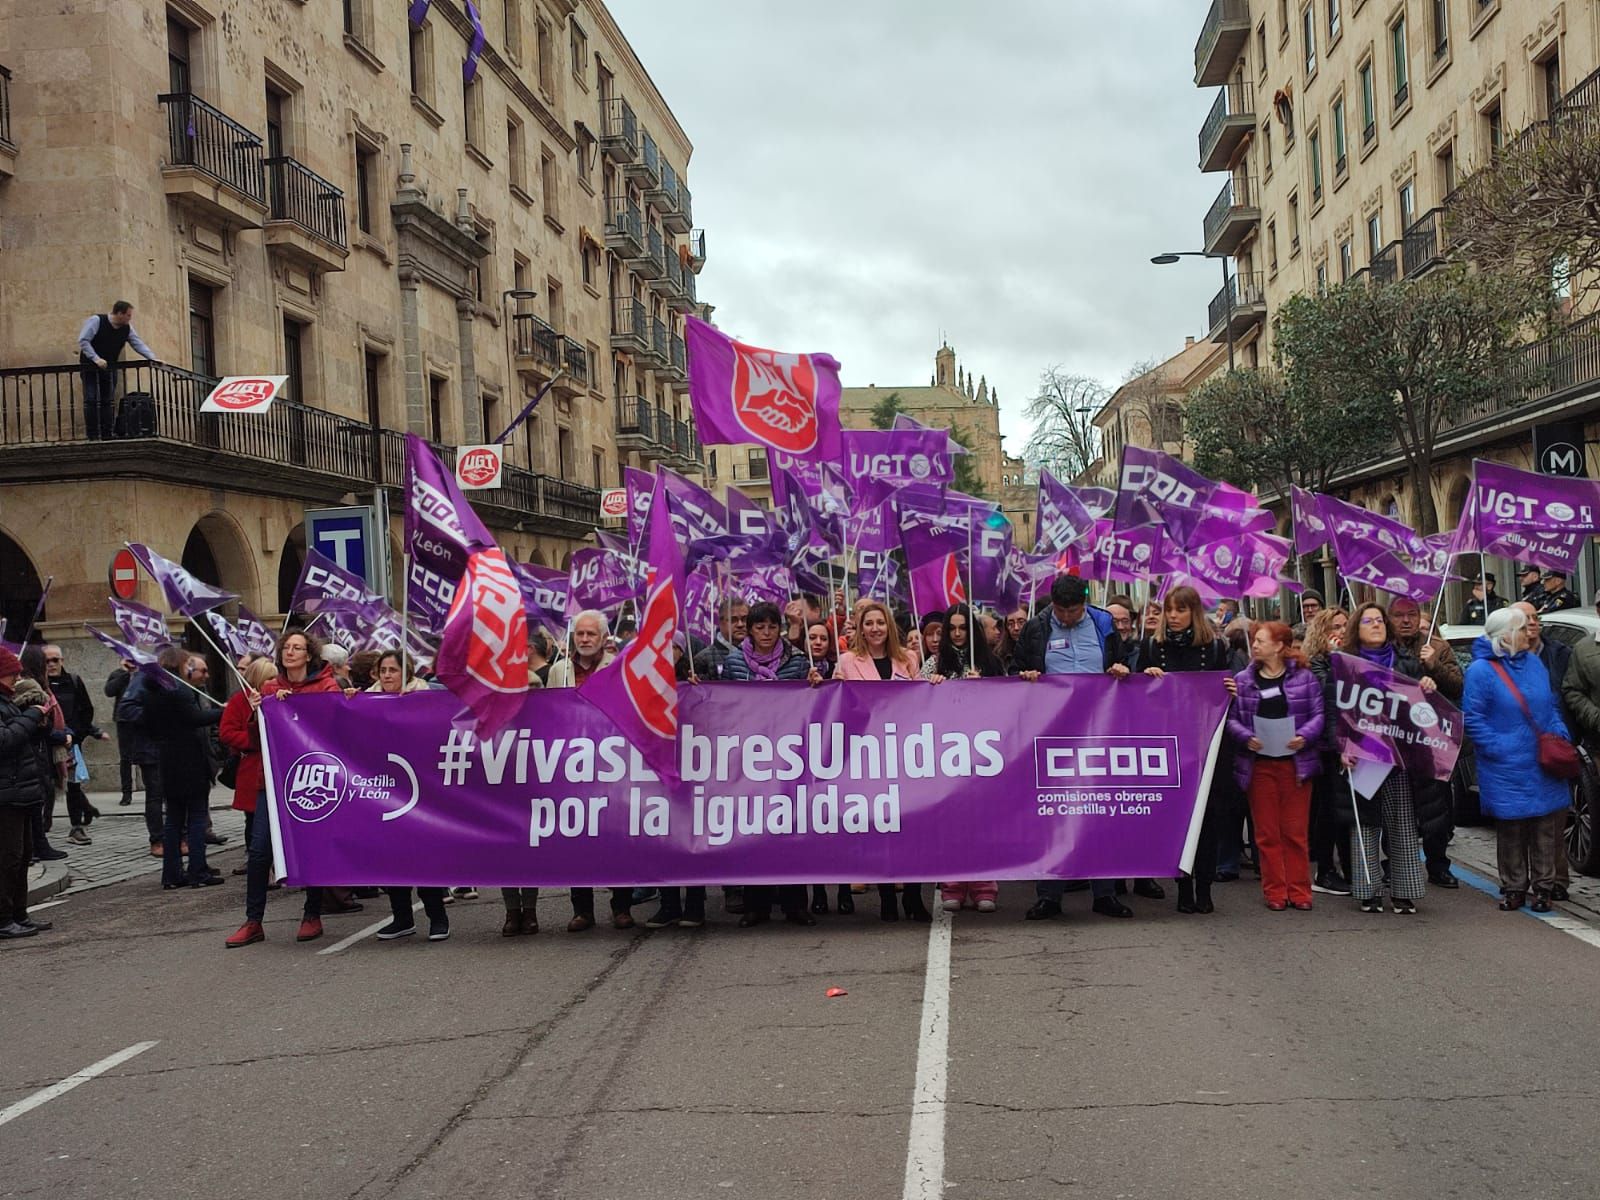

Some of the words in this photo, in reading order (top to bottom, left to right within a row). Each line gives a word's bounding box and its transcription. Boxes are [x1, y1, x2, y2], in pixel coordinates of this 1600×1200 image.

[222, 382, 270, 396] UGT
[464, 454, 495, 470] UGT
[851, 453, 906, 479] UGT
[1478, 485, 1539, 519] UGT
[418, 530, 453, 563] León
[1529, 541, 1537, 552] y
[1540, 542, 1569, 559] León
[410, 562, 456, 605] CCO
[1336, 680, 1408, 720] UGT
[1358, 718, 1405, 739] Castilla
[1406, 731, 1414, 744] y
[1415, 731, 1448, 751] León
[437, 722, 1004, 786] #VivasLbresUnidas
[1047, 747, 1168, 777] CCOO
[292, 764, 340, 790] UGT
[351, 774, 396, 788] Castilla
[349, 788, 356, 802] y
[359, 787, 390, 800] León
[1037, 791, 1111, 803] comisiones
[1114, 791, 1163, 802] obreras
[529, 796, 608, 847] por
[629, 787, 670, 837] la
[693, 784, 901, 846] igualdad
[1038, 804, 1054, 816] de
[1058, 803, 1106, 815] Castilla
[1109, 806, 1117, 816] y
[1120, 803, 1151, 815] León
